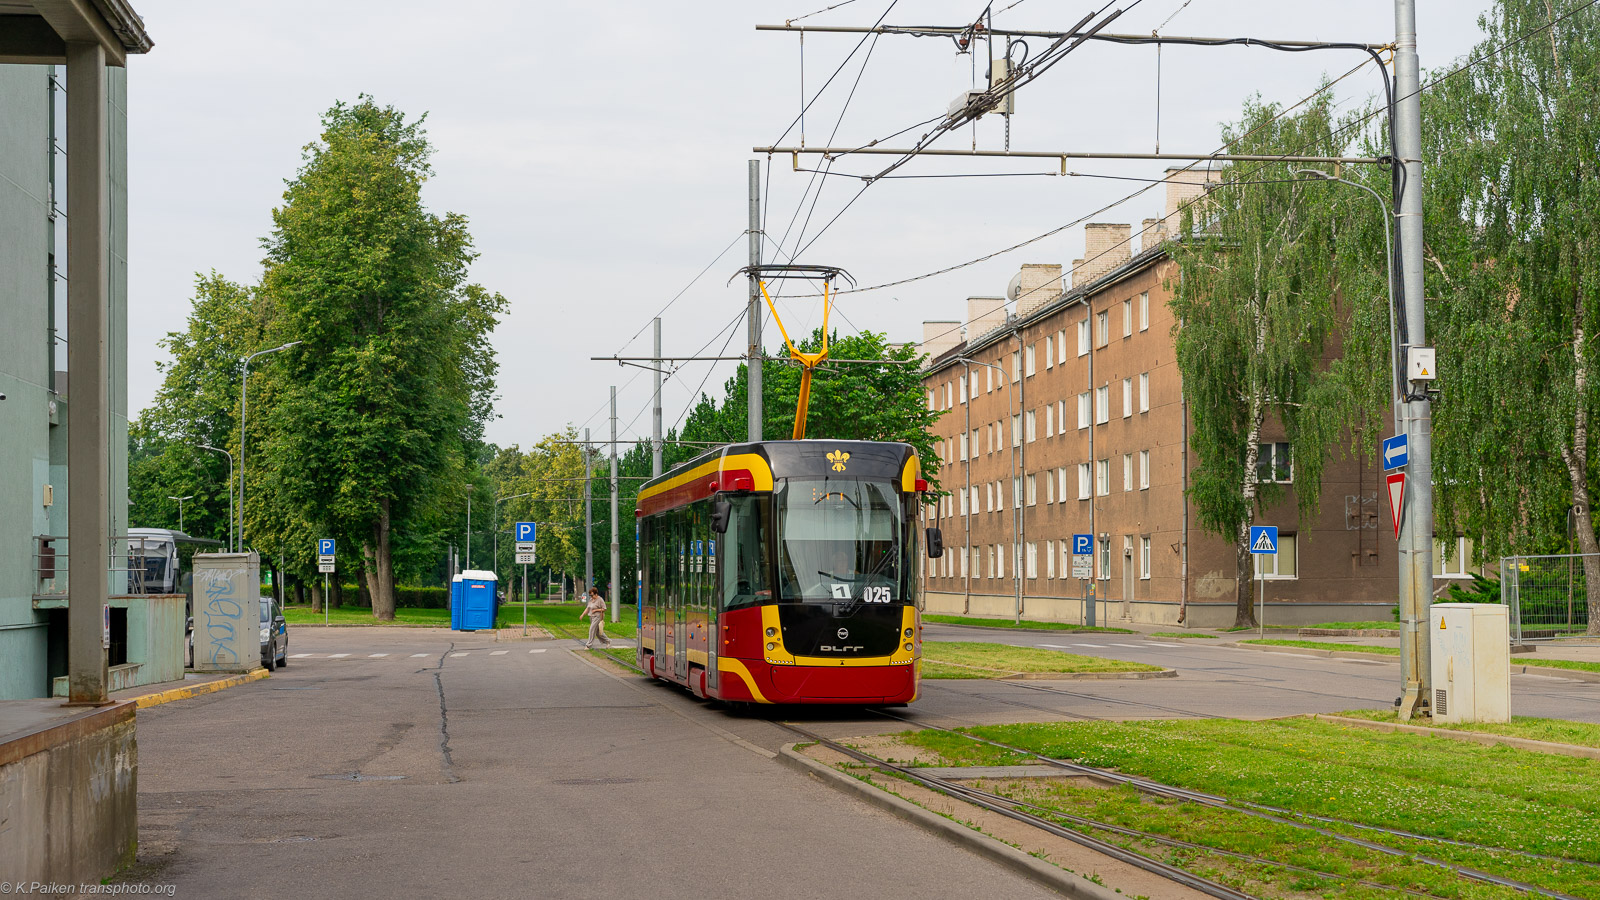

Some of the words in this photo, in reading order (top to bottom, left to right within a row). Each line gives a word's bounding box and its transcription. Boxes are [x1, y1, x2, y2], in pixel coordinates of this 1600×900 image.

[520, 524, 531, 540] P
[322, 541, 332, 553] P
[1077, 536, 1089, 553] P
[835, 586, 846, 597] 1
[863, 586, 891, 603] 025
